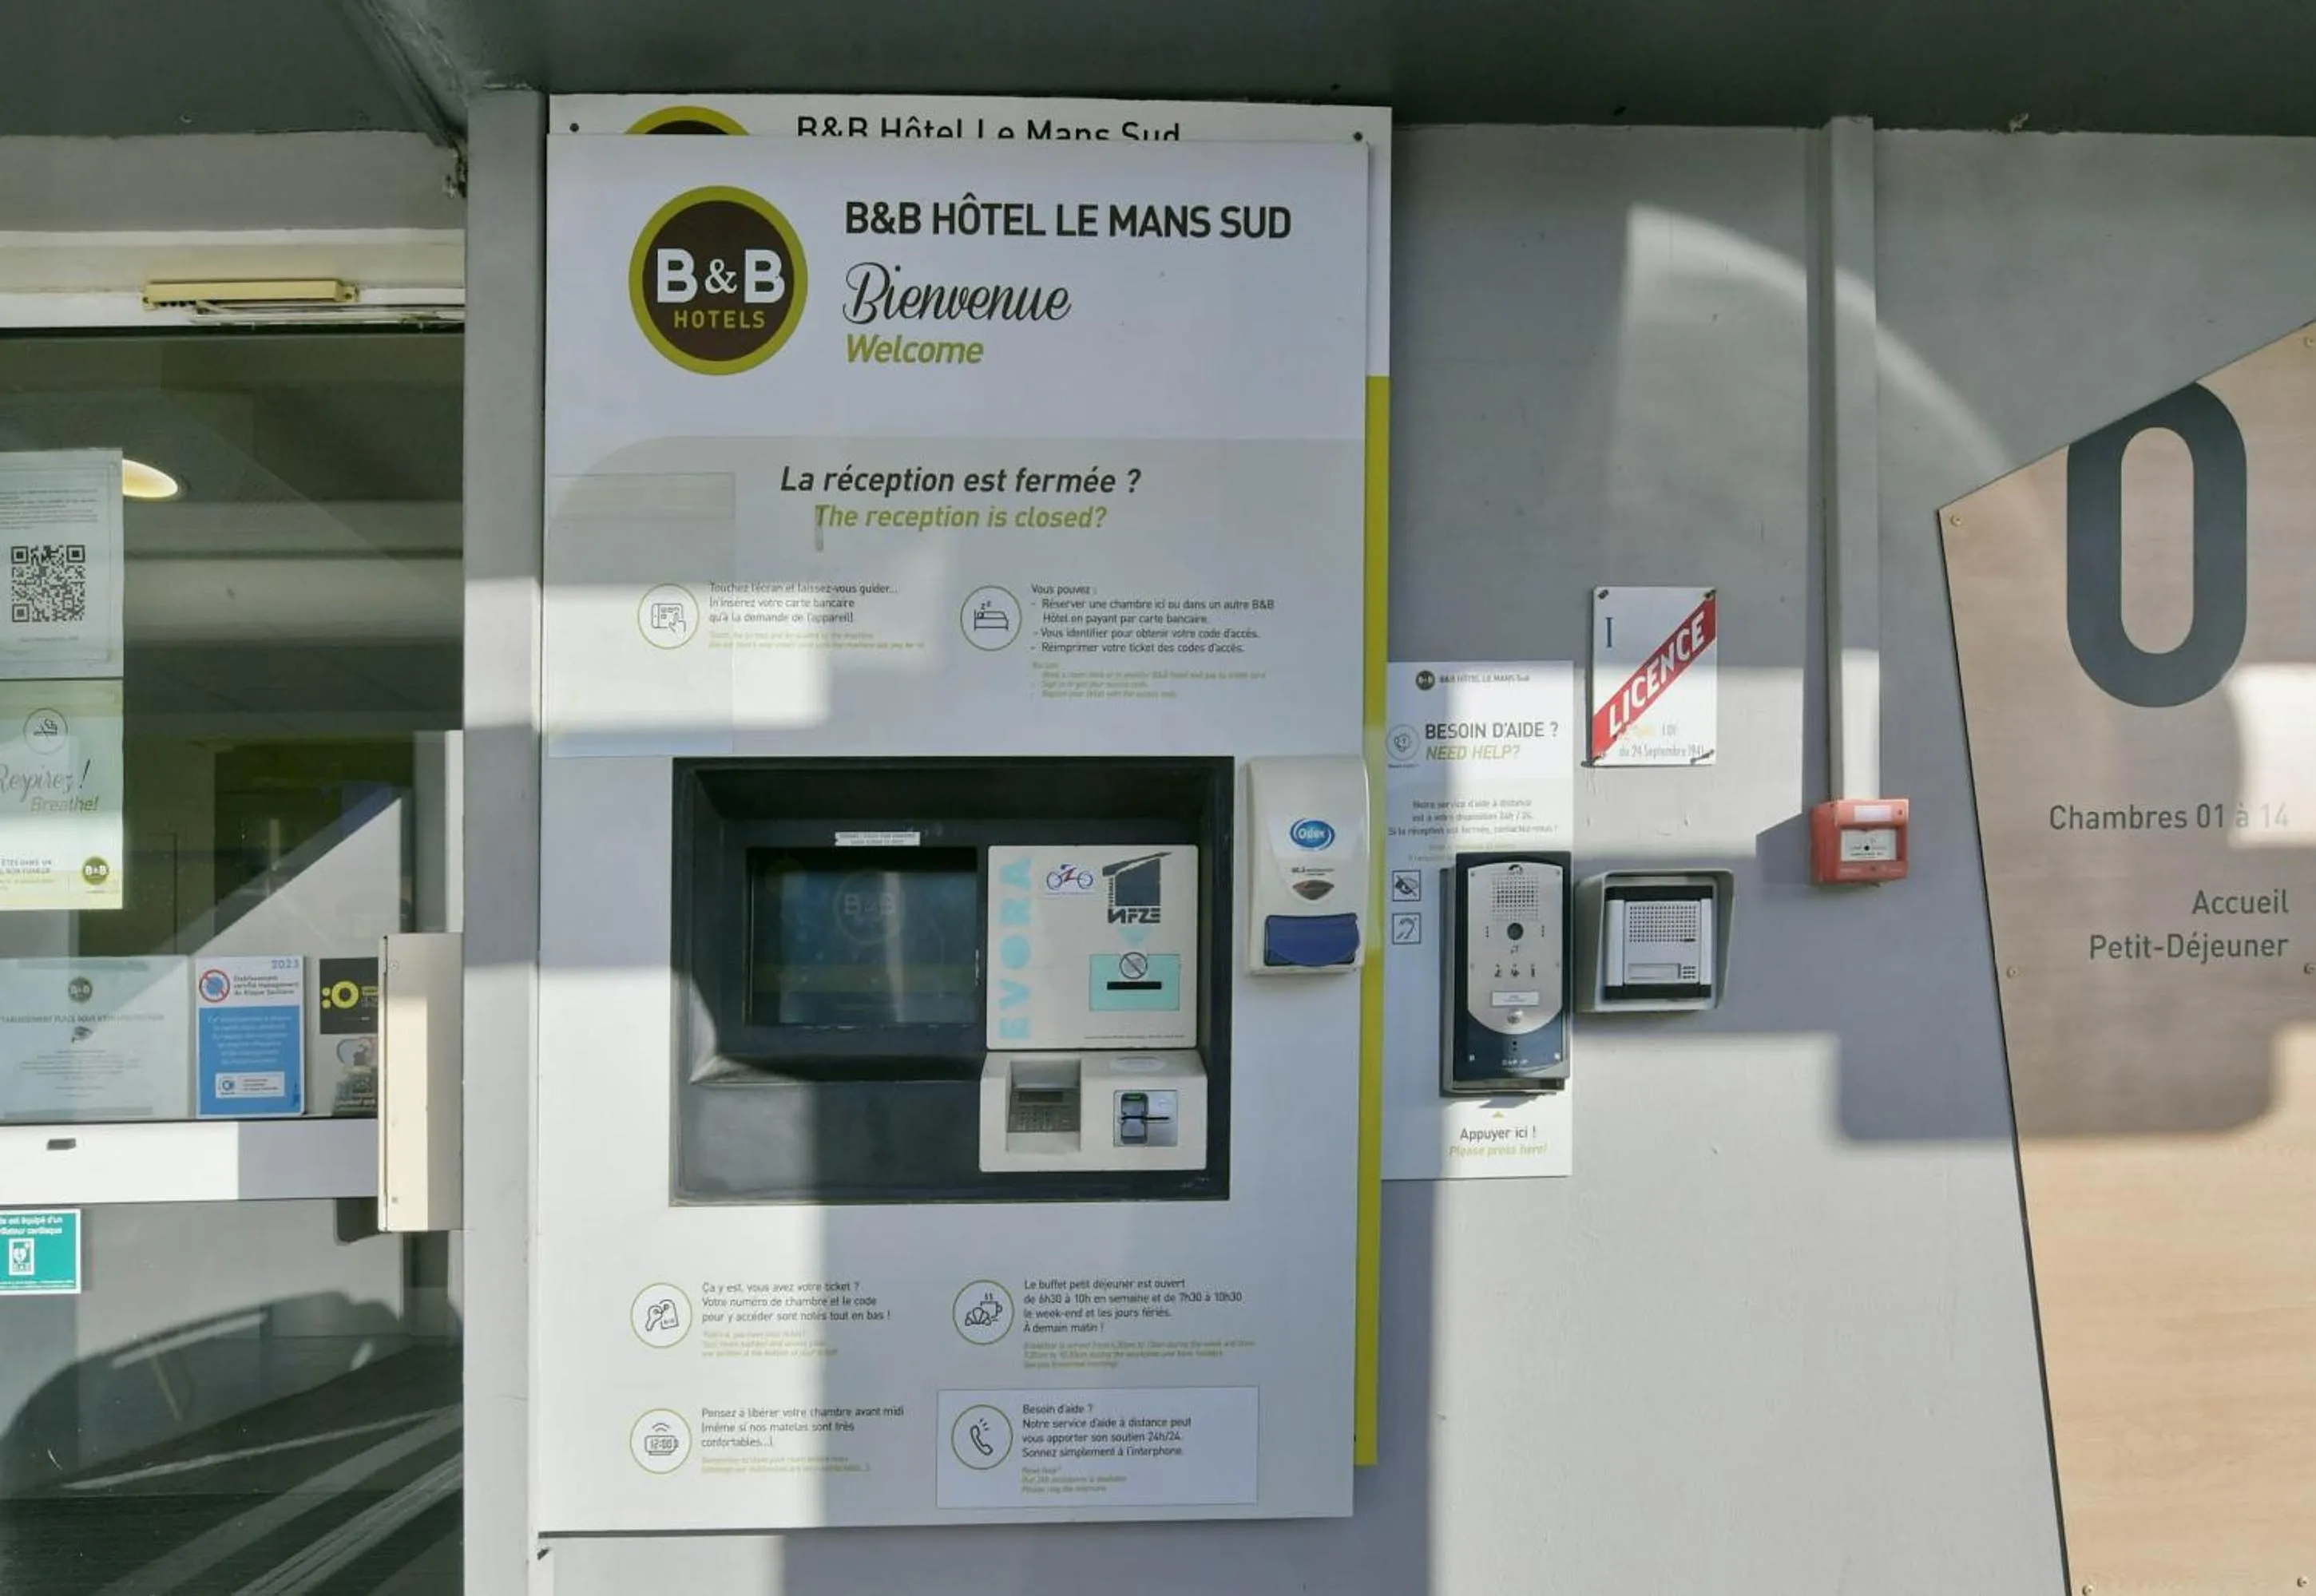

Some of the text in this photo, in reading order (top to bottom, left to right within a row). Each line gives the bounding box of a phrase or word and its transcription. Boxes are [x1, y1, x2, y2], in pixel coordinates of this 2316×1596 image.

[847, 192, 1291, 239] B&B HÔTEL LE MANS SUD
[656, 248, 785, 303] B&B
[843, 262, 1072, 324] Bienvenue
[674, 310, 765, 328] HOTELS
[847, 334, 984, 364] Welcome
[781, 464, 1141, 497] La réception est fermée ?
[815, 505, 1108, 532] The reception is closed?
[1031, 584, 1091, 597] Vous pouvez
[1041, 598, 1275, 610] Réserver une chambre ici dans autre B&B
[1042, 612, 1070, 624] Hôtel
[1085, 614, 1117, 625] payant
[1120, 616, 1137, 626] par
[1138, 614, 1164, 624] carte
[1040, 627, 1065, 639] Vous
[1065, 628, 1109, 638] identifier
[1110, 630, 1134, 640] pour
[1135, 628, 1171, 639] obtenir
[1171, 629, 1196, 639] votre
[1197, 628, 1221, 639] code
[1041, 642, 1100, 654] Réimprimer
[1100, 644, 1127, 652] votre
[1128, 643, 1155, 652] ticket
[1157, 642, 1175, 652] des
[1176, 642, 1206, 652] codes
[1609, 612, 1704, 738] LICENCE
[1426, 721, 1558, 739] BESOIN D'AIDE ?
[1426, 745, 1521, 760] NEED HELP?
[2049, 802, 2289, 830] Chambres 01 à 14
[2192, 889, 2288, 914] Accueil
[1000, 857, 1033, 1040] EVORA
[2090, 932, 2289, 964] Petit-Déjeuner
[1460, 1127, 1529, 1143] Appuyer ici
[1024, 1279, 1185, 1291] Le buffet petit déjeuner est ouvert
[1038, 1292, 1243, 1304] 6h30 10h semaine 7h30 10h30
[1035, 1308, 1084, 1319] week-end
[1097, 1308, 1113, 1317] les
[1114, 1308, 1140, 1319] jours
[1032, 1322, 1098, 1333] demain matin
[1022, 1404, 1085, 1416] Besoin d'aide
[1022, 1417, 1192, 1431] Notre service d'aide distance peut
[1021, 1435, 1045, 1444] vous
[1046, 1434, 1089, 1445] apporter
[1090, 1432, 1108, 1442] son
[1110, 1432, 1146, 1443] soutien
[1021, 1447, 1057, 1457] Sonnez
[1058, 1447, 1116, 1458] simplement
